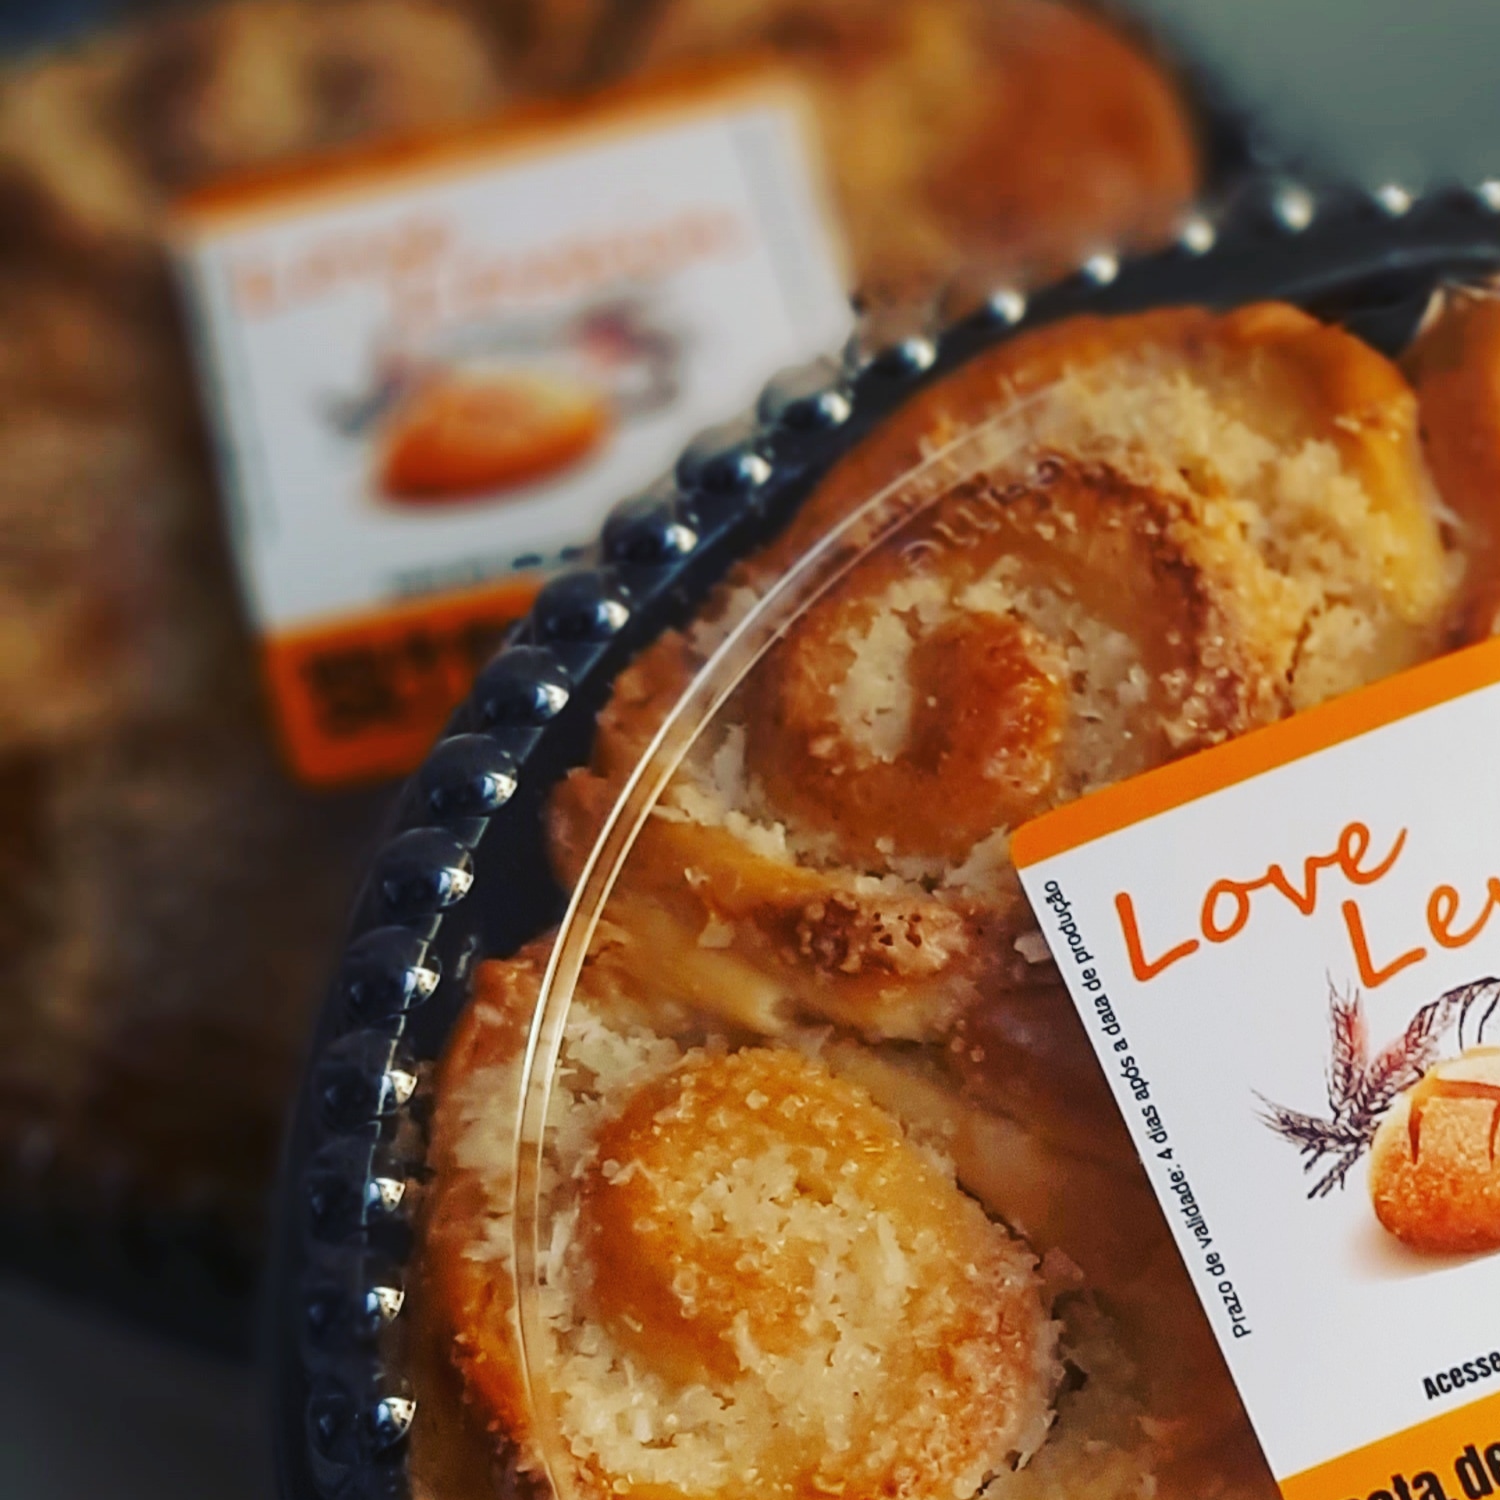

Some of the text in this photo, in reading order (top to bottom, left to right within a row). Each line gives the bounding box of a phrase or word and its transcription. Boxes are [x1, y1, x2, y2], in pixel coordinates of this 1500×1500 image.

[1115, 822, 1408, 983] Love
[1044, 880, 1253, 1338] Prazo de validade: 4 dias após a data de produção
